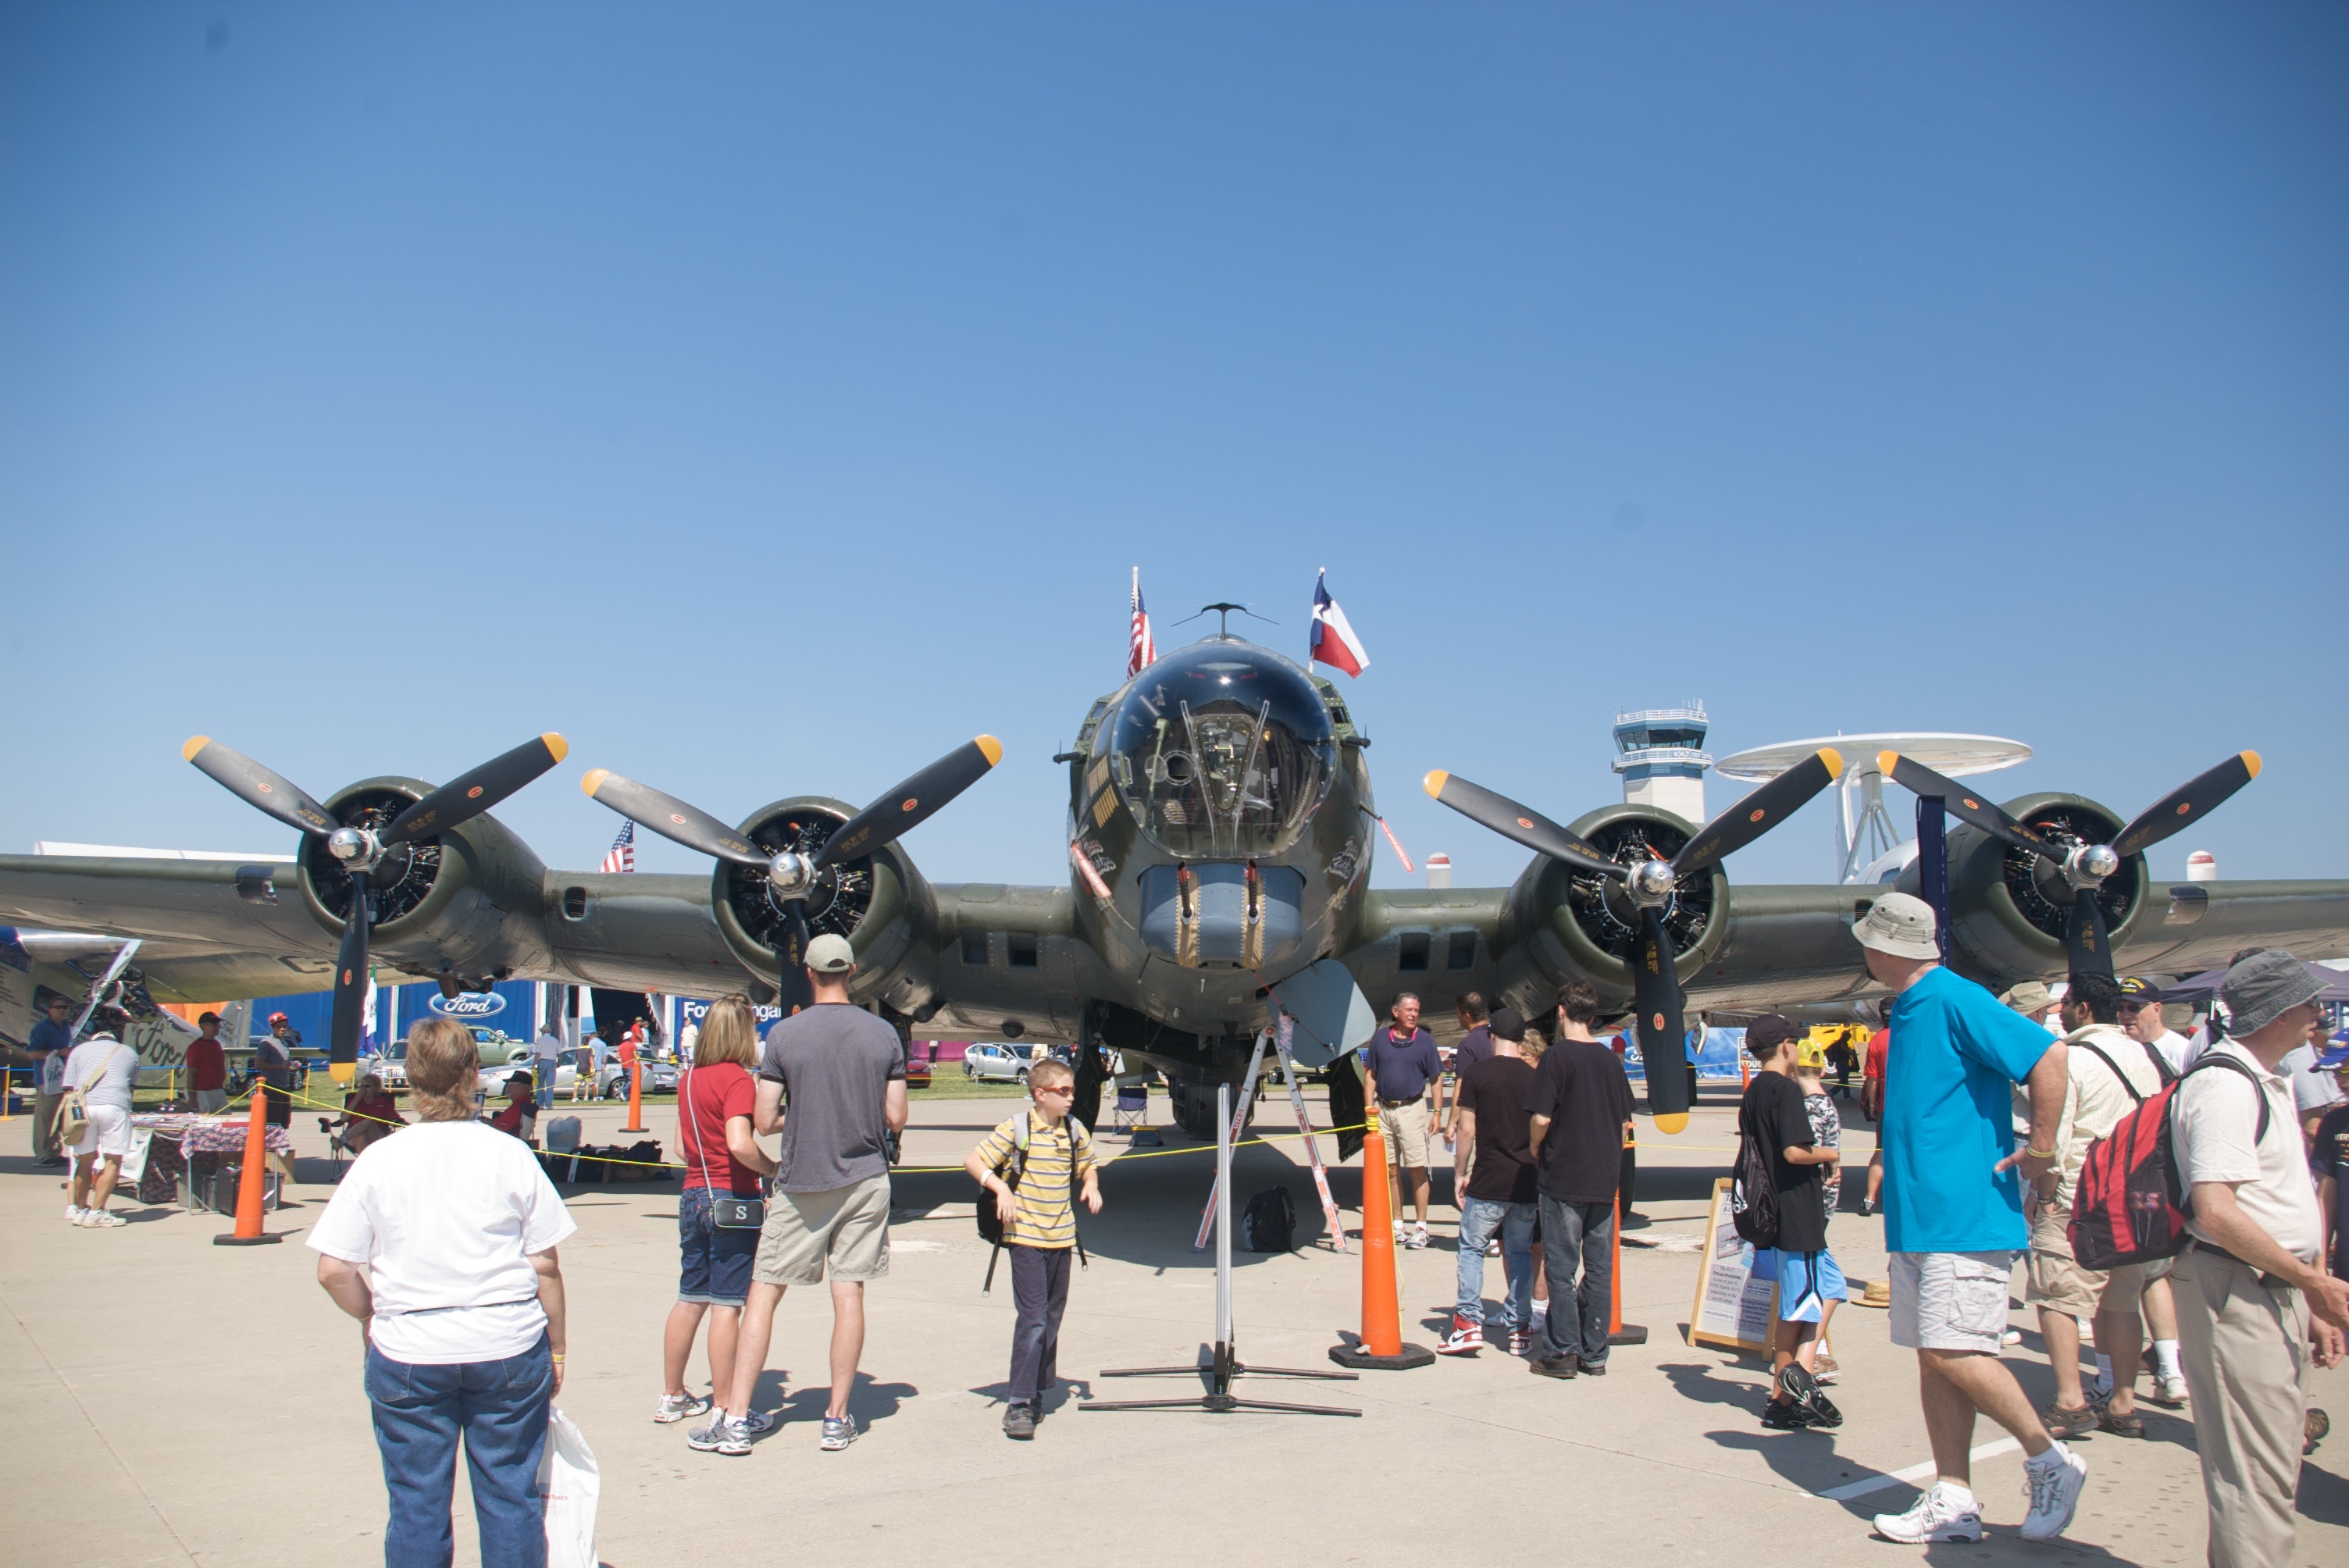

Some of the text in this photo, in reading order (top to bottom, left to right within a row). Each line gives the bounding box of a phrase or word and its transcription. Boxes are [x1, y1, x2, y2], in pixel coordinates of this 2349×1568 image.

[444, 992, 491, 1012] Ford
[684, 1001, 781, 1021] Fo nga
[736, 1206, 747, 1219] S
